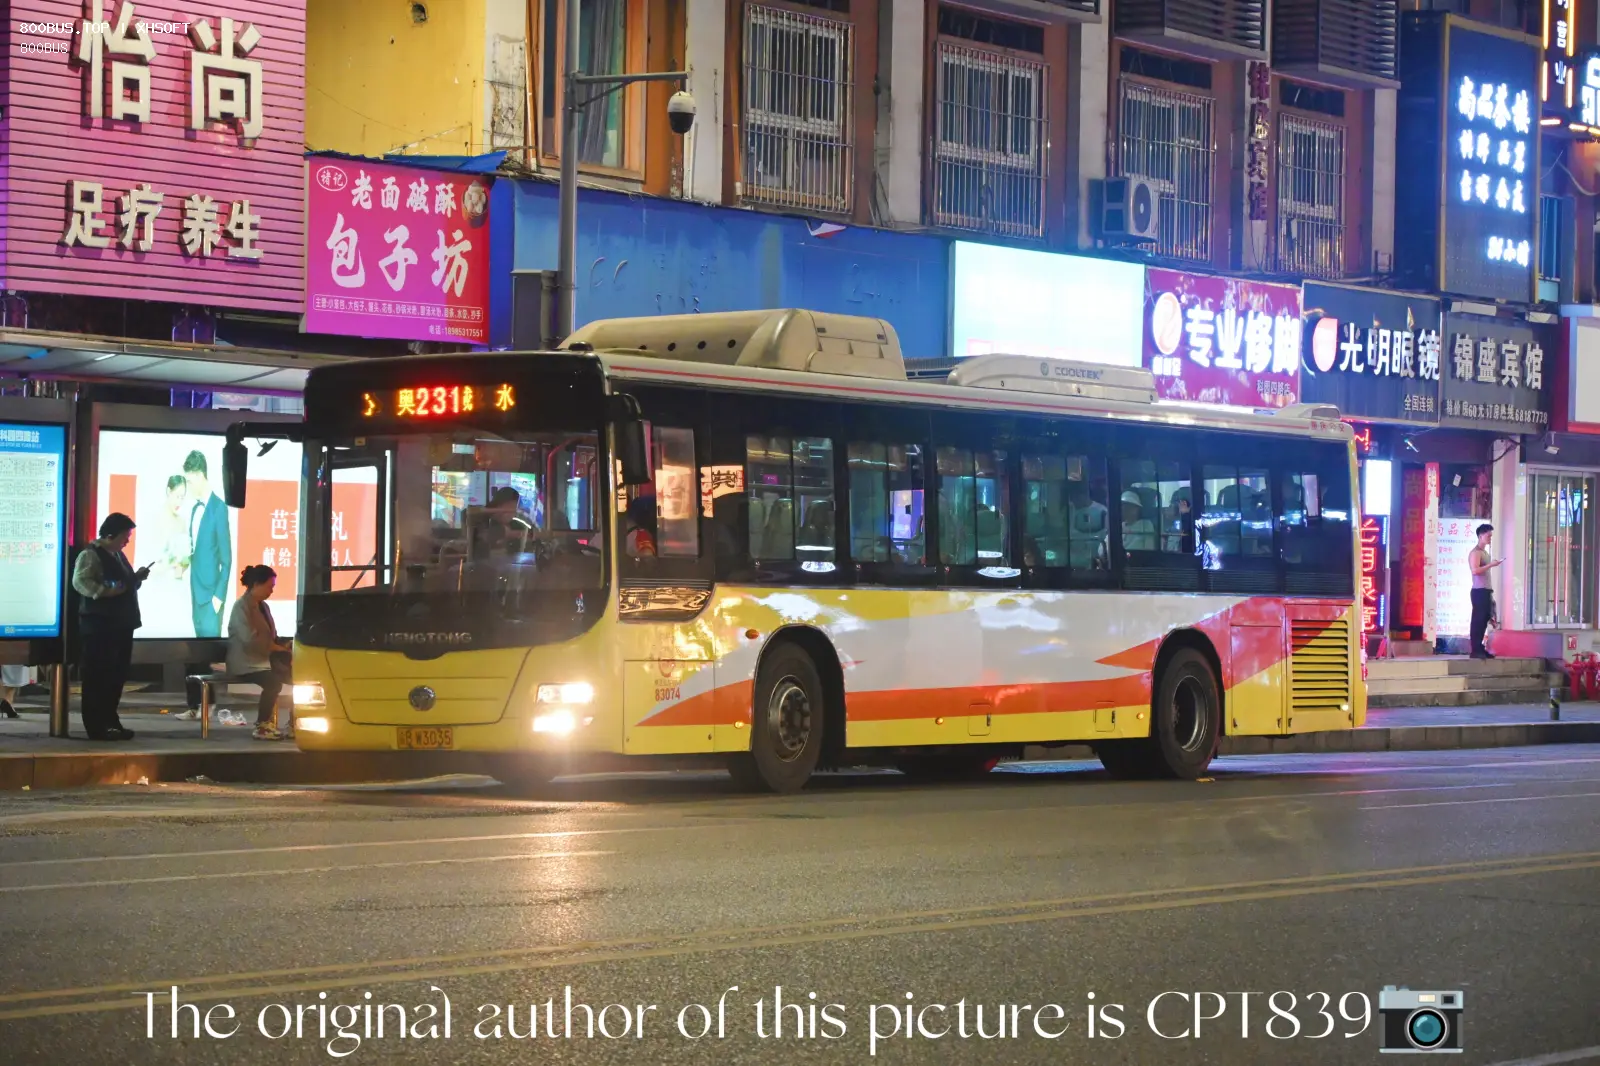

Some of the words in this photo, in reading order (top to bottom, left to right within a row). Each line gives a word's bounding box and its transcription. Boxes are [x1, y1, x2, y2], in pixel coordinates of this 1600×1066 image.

[75, 0, 263, 142] 怡尚
[61, 180, 264, 259] 足疗养生
[351, 169, 457, 217] 老面破酥
[326, 212, 473, 298] 包子坊
[1185, 304, 1300, 376] 专业修脚
[1340, 322, 1440, 380] 光明眼镜
[1453, 332, 1544, 390] 锦盛宾馆
[1054, 367, 1100, 380] COOLTEK
[1404, 393, 1434, 412] 全国连锁
[655, 686, 680, 702] 83074
